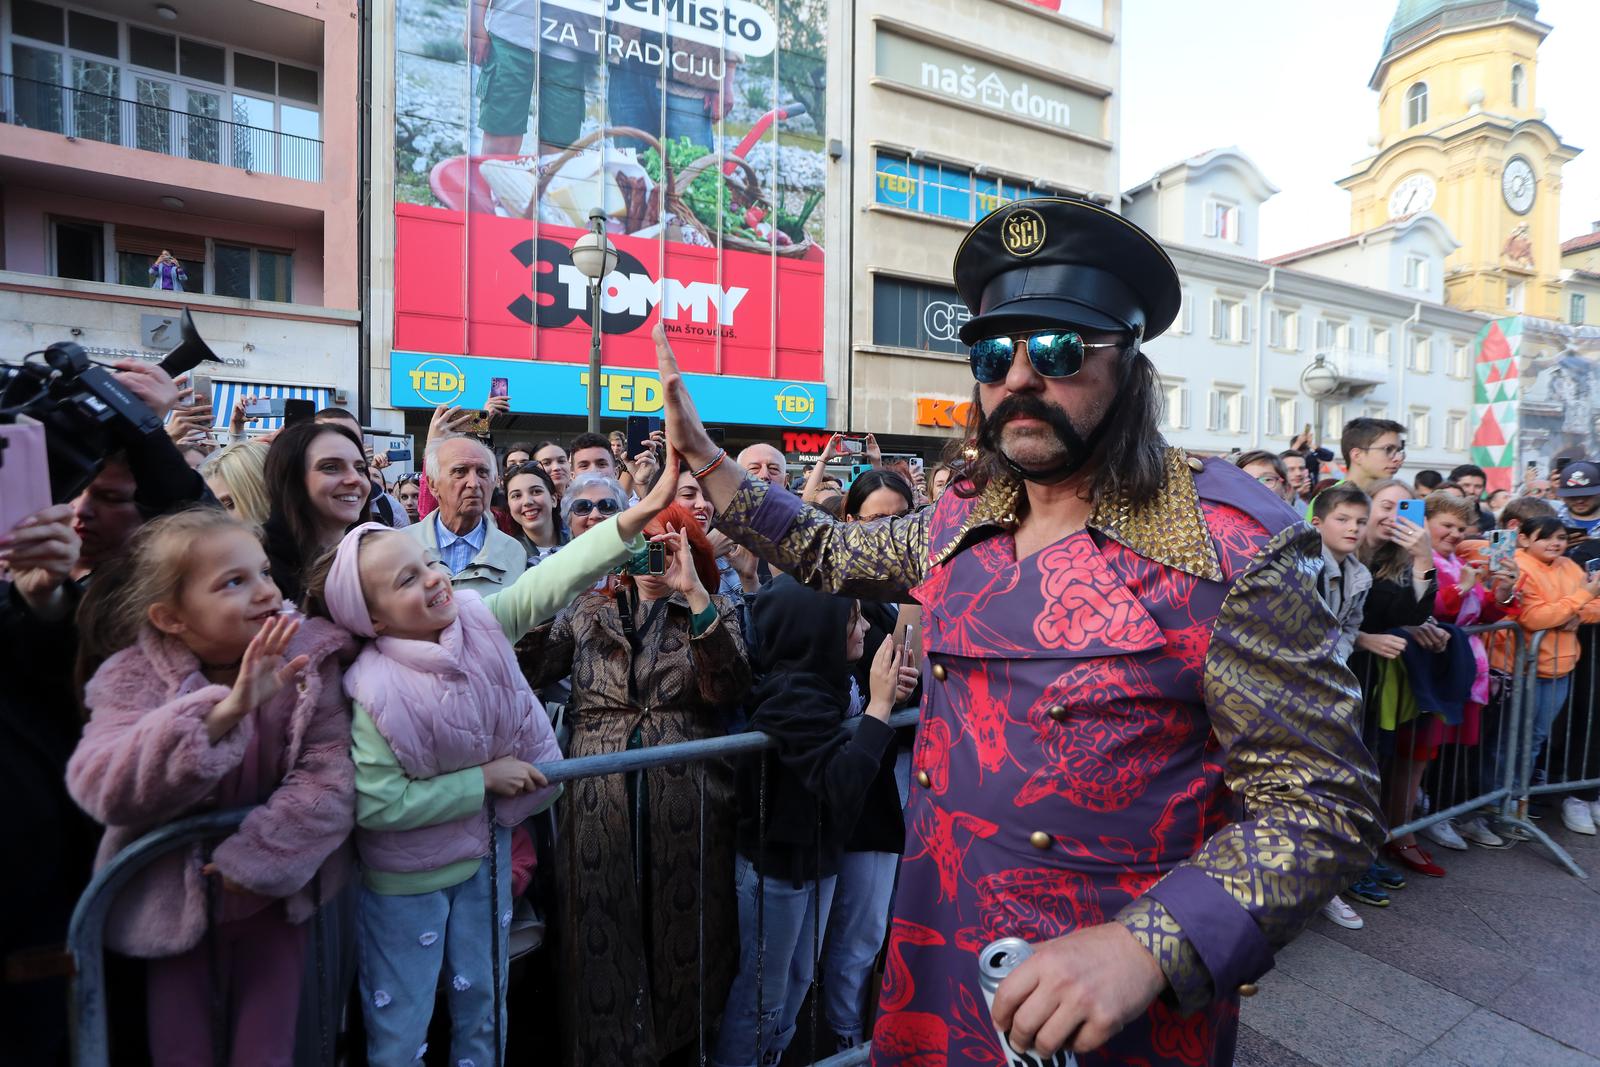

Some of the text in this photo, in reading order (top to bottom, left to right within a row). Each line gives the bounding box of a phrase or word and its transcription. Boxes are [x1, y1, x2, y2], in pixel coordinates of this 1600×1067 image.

[541, 17, 727, 81] ZA TRADICIJU
[921, 61, 1070, 126] naš dom
[558, 263, 750, 326] TOMMY
[685, 323, 704, 335] ŠTO
[409, 370, 466, 392] TEDi
[580, 372, 665, 412] TED
[774, 394, 815, 412] TEDi
